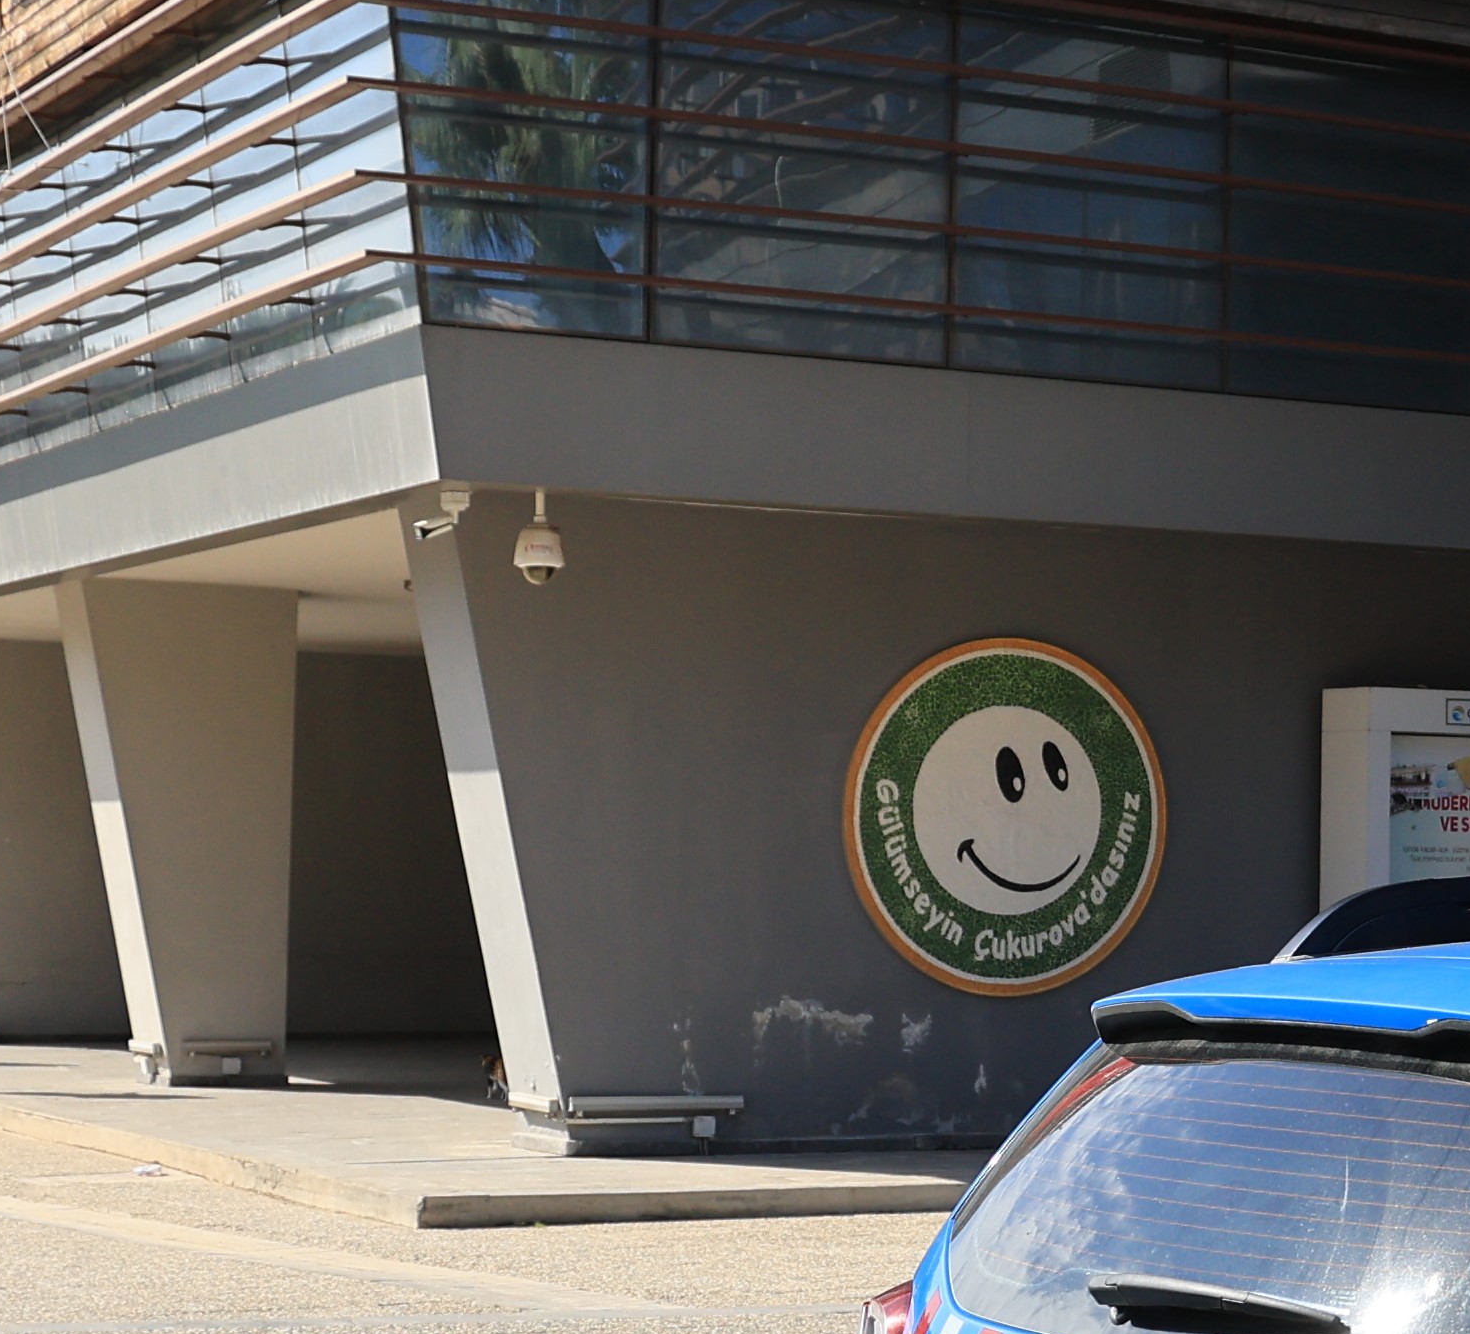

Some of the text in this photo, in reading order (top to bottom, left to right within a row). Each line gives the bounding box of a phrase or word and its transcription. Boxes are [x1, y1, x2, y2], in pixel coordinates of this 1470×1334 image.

[875, 778, 1141, 962] Gülümseyin Çukurova'dasınız
[1440, 816, 1459, 832] VE
